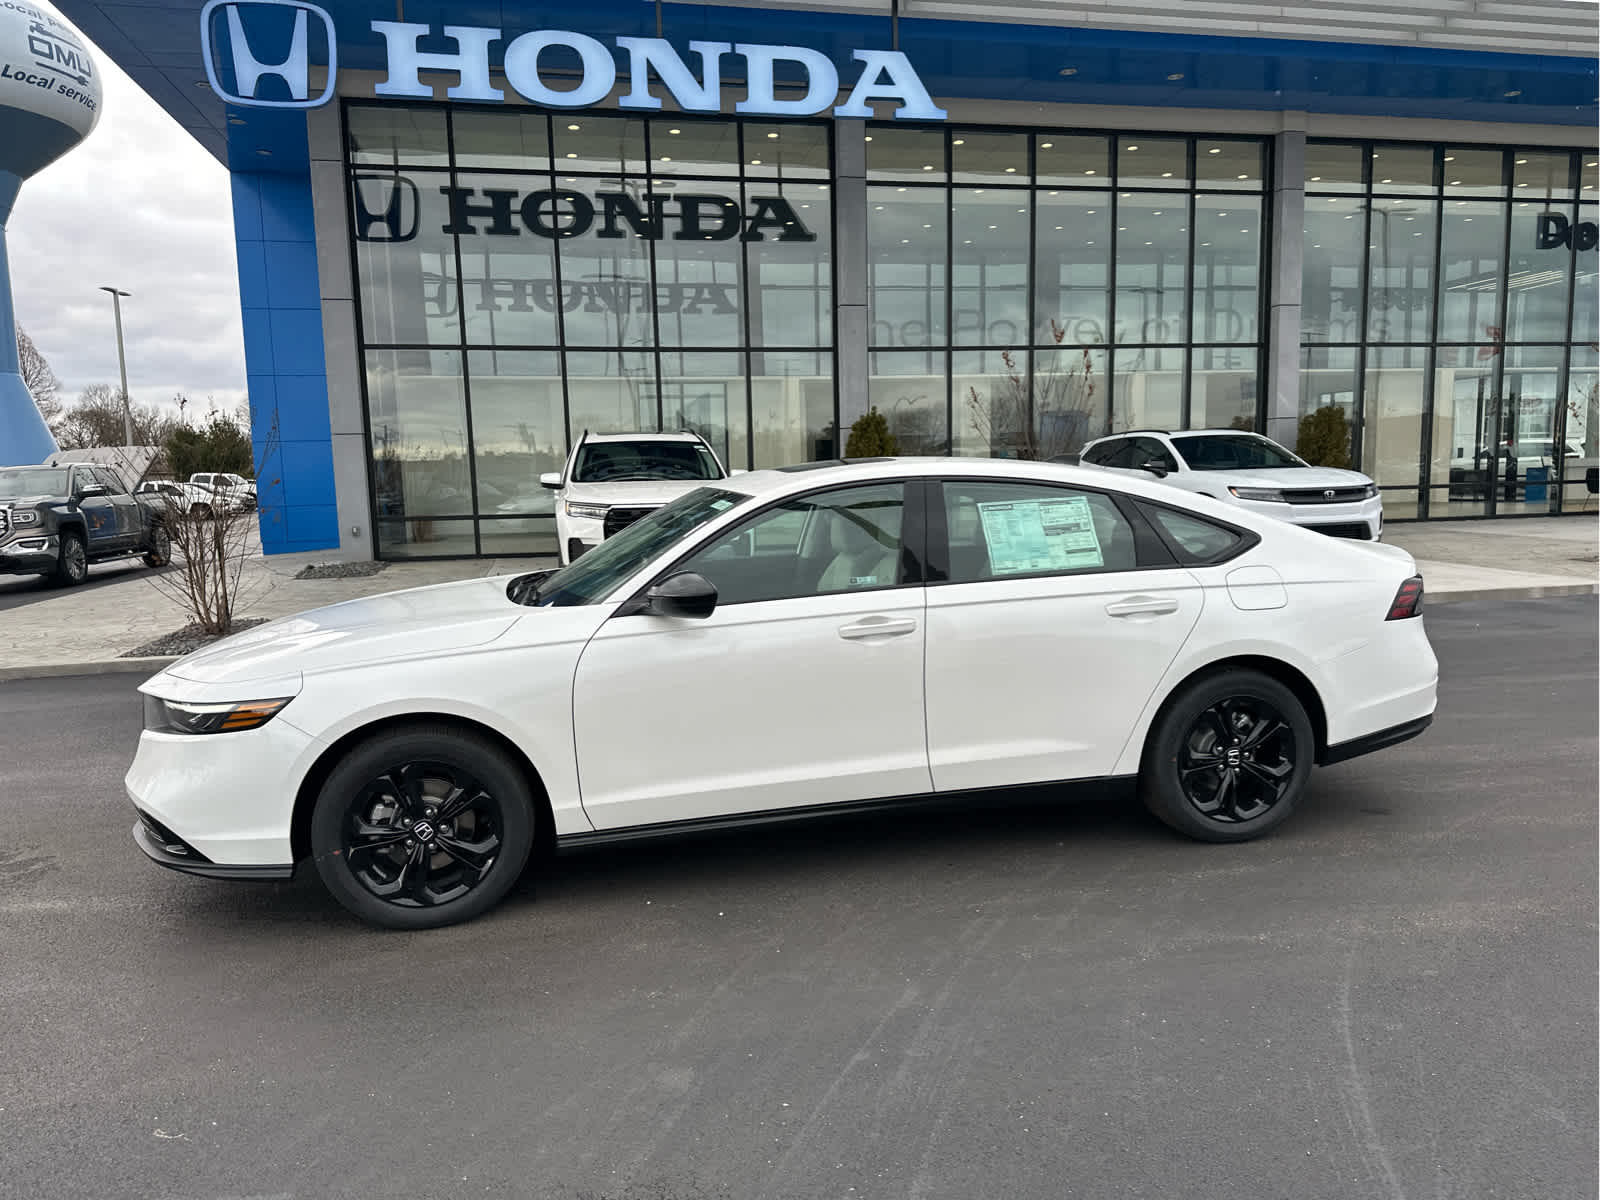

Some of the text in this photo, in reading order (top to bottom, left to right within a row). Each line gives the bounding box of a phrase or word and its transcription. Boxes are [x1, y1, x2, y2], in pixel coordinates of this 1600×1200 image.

[0, 2, 42, 20] ocal
[1, 64, 55, 89] Local
[370, 20, 948, 120] HONDA
[439, 185, 818, 242] HONDA
